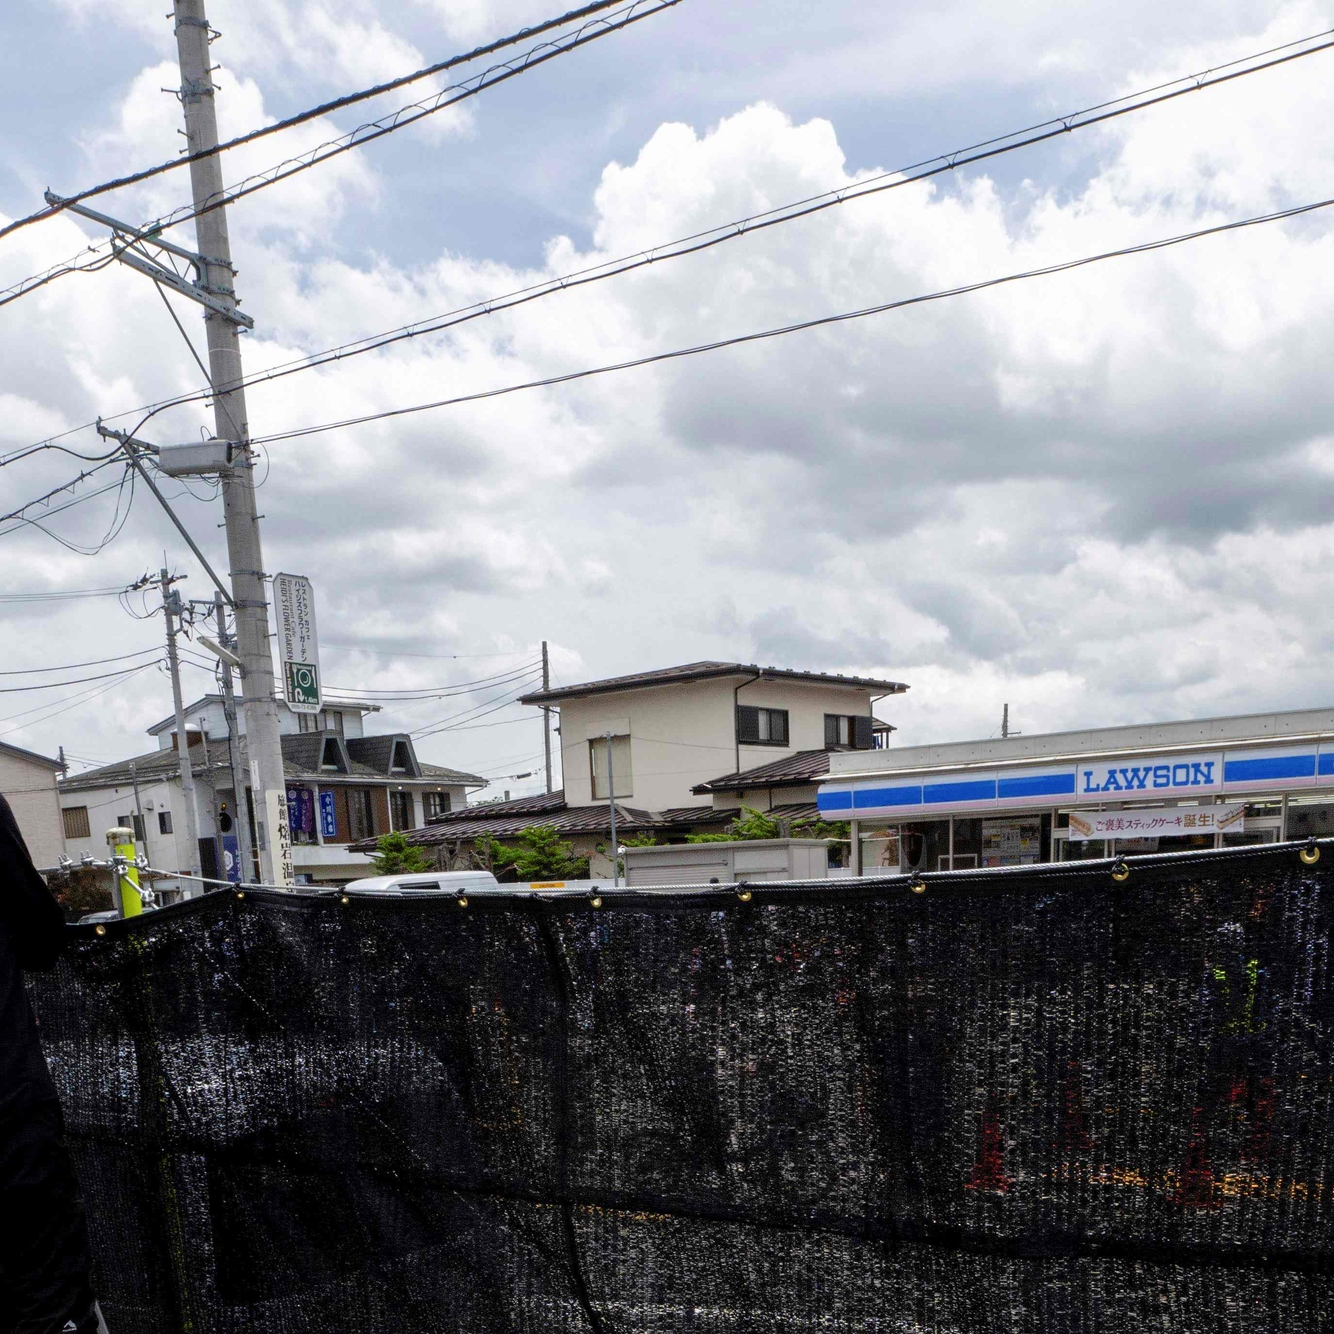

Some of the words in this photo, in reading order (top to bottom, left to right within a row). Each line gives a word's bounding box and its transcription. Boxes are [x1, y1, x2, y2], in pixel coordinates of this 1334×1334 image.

[282, 604, 292, 633] FLOWER
[285, 632, 295, 661] GARDEN
[1083, 761, 1215, 793] LAWSON
